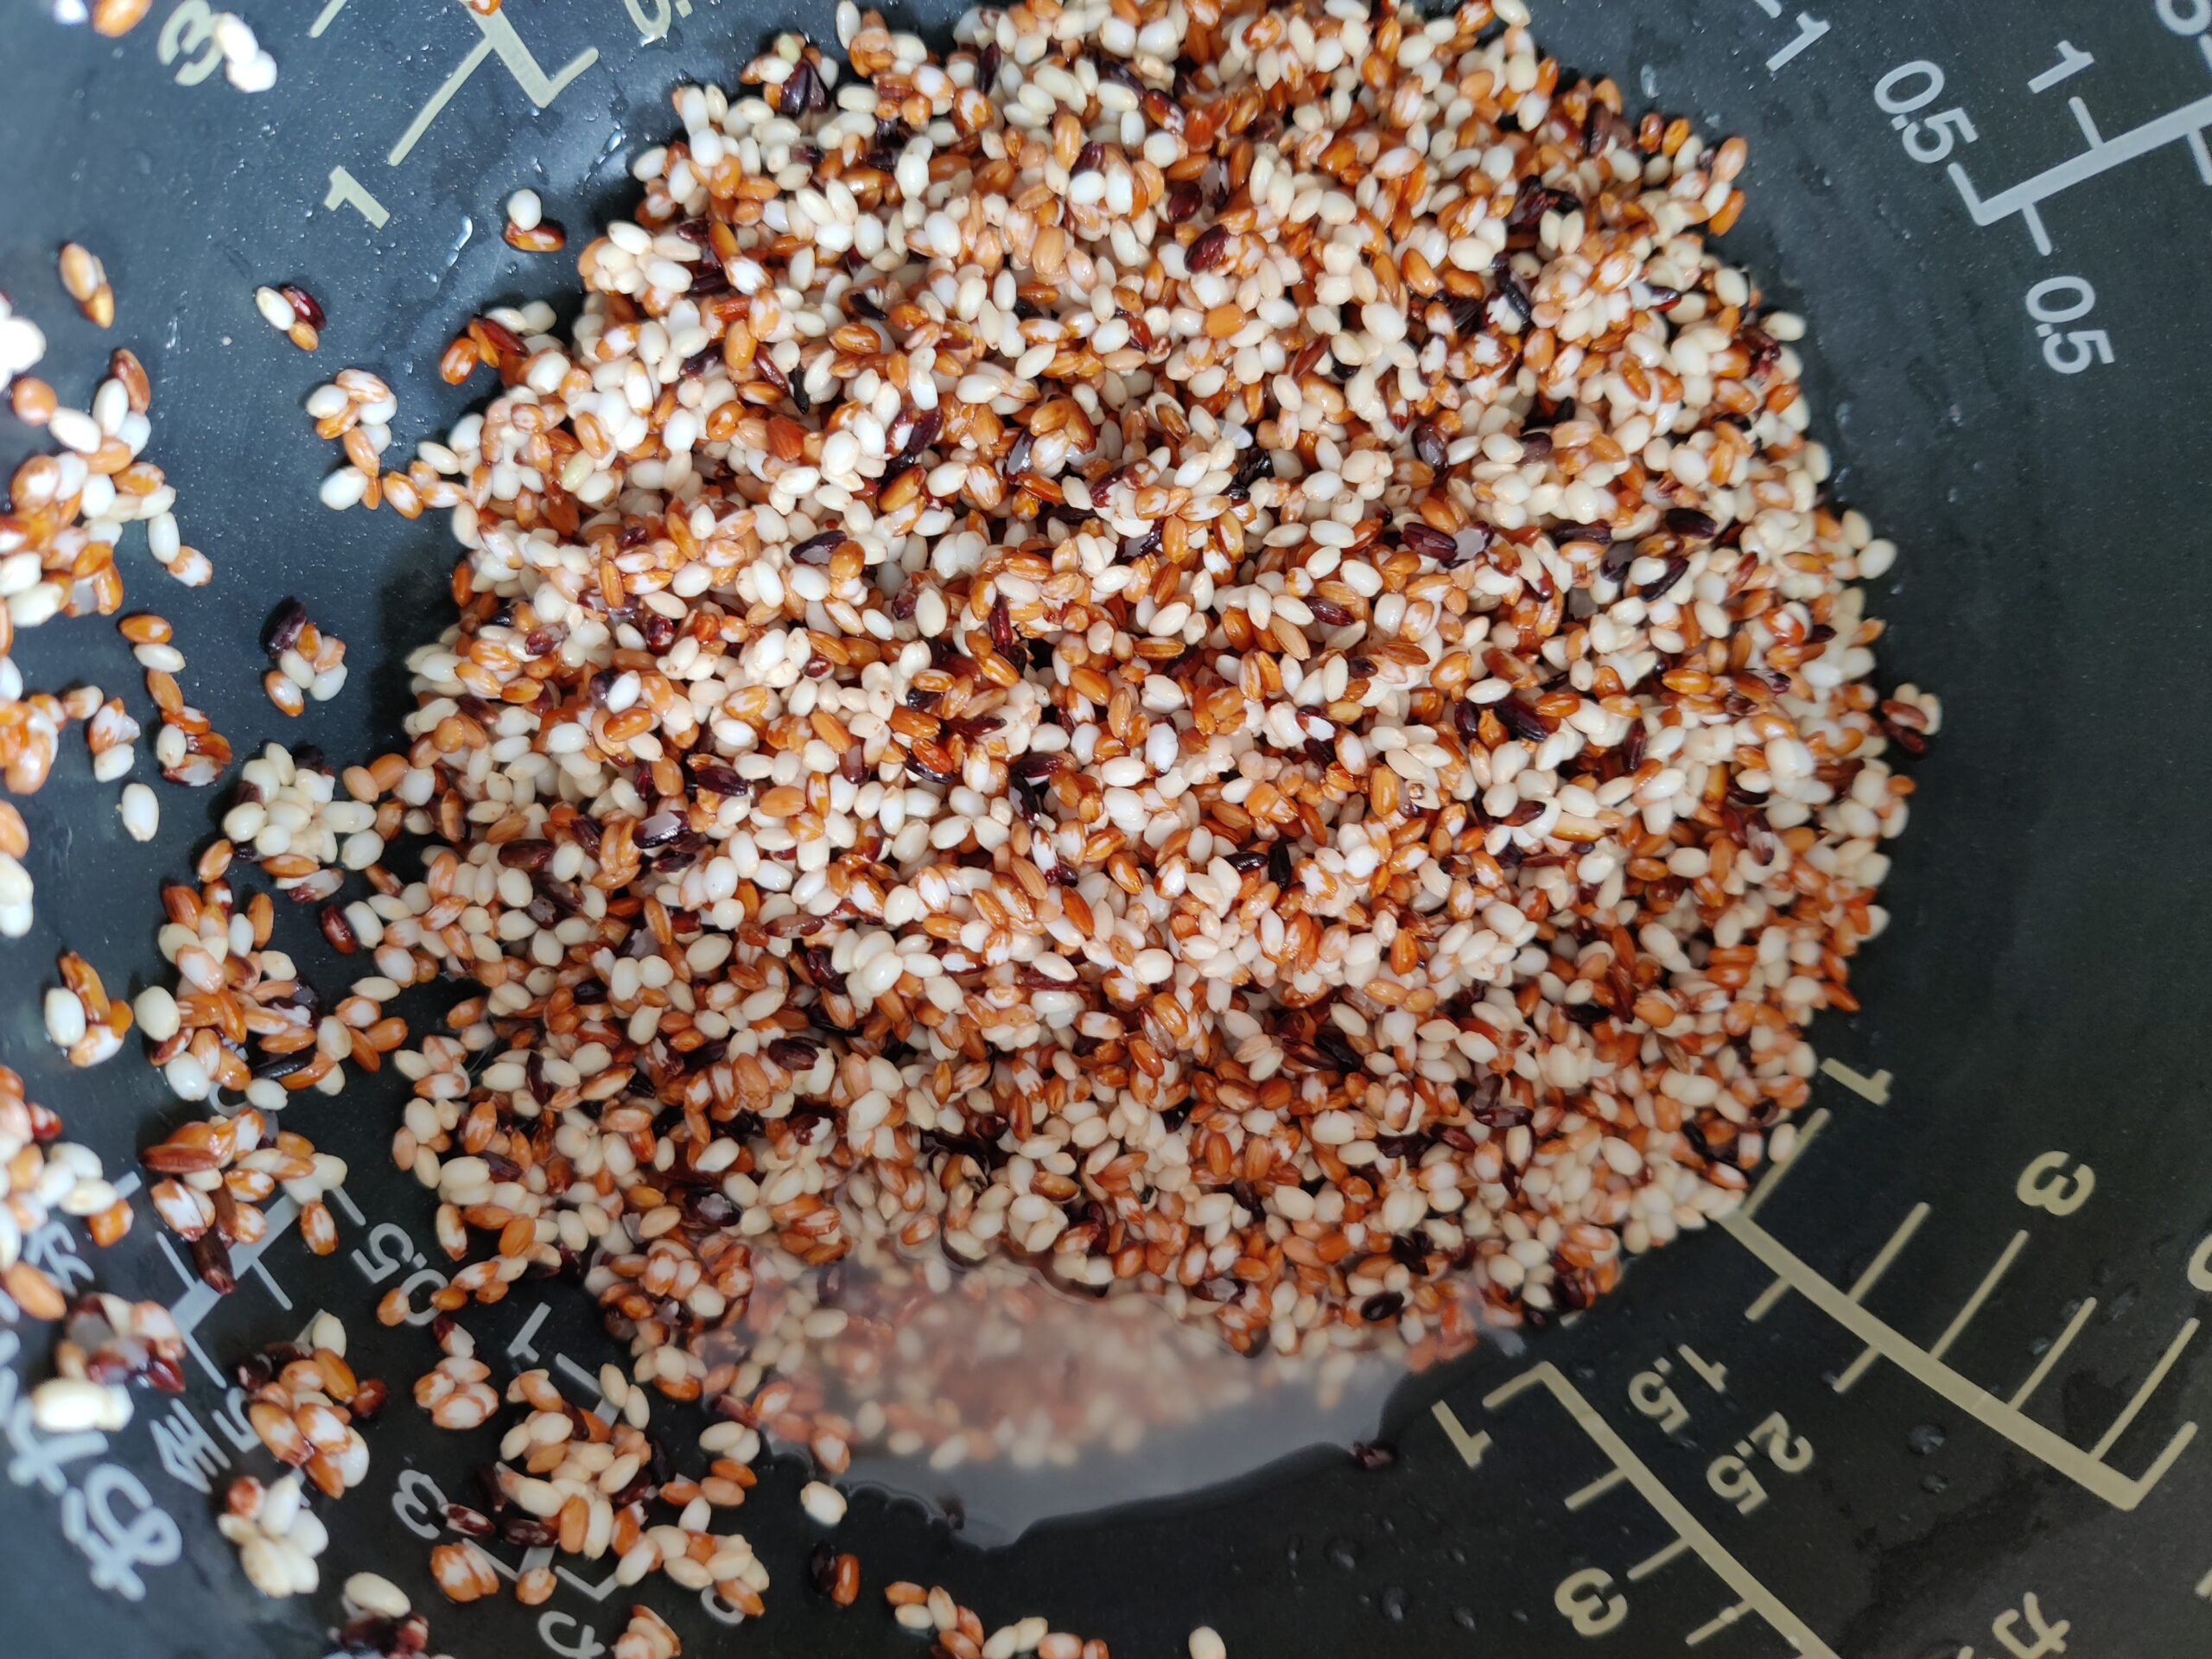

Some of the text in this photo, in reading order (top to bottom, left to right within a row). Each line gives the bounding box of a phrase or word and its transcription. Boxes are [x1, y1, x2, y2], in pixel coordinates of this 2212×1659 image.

[158, 0, 224, 86] 3
[1765, 10, 1832, 72] 1
[2027, 40, 2094, 94] 1
[1874, 60, 1979, 163] 0.5
[323, 164, 391, 230] 1
[2025, 276, 2115, 373] 0.5
[1820, 1058, 1894, 1107] 1
[2016, 1150, 2096, 1217] 3
[352, 1222, 451, 1325] 0.5
[507, 1301, 552, 1363] 1
[1628, 1344, 1728, 1433] 1.5
[149, 1397, 232, 1495] 全
[1431, 1399, 1494, 1468] 1
[1706, 1410, 1815, 1516] 2.5
[392, 1469, 449, 1540] 3
[1554, 1567, 1629, 1637] 3
